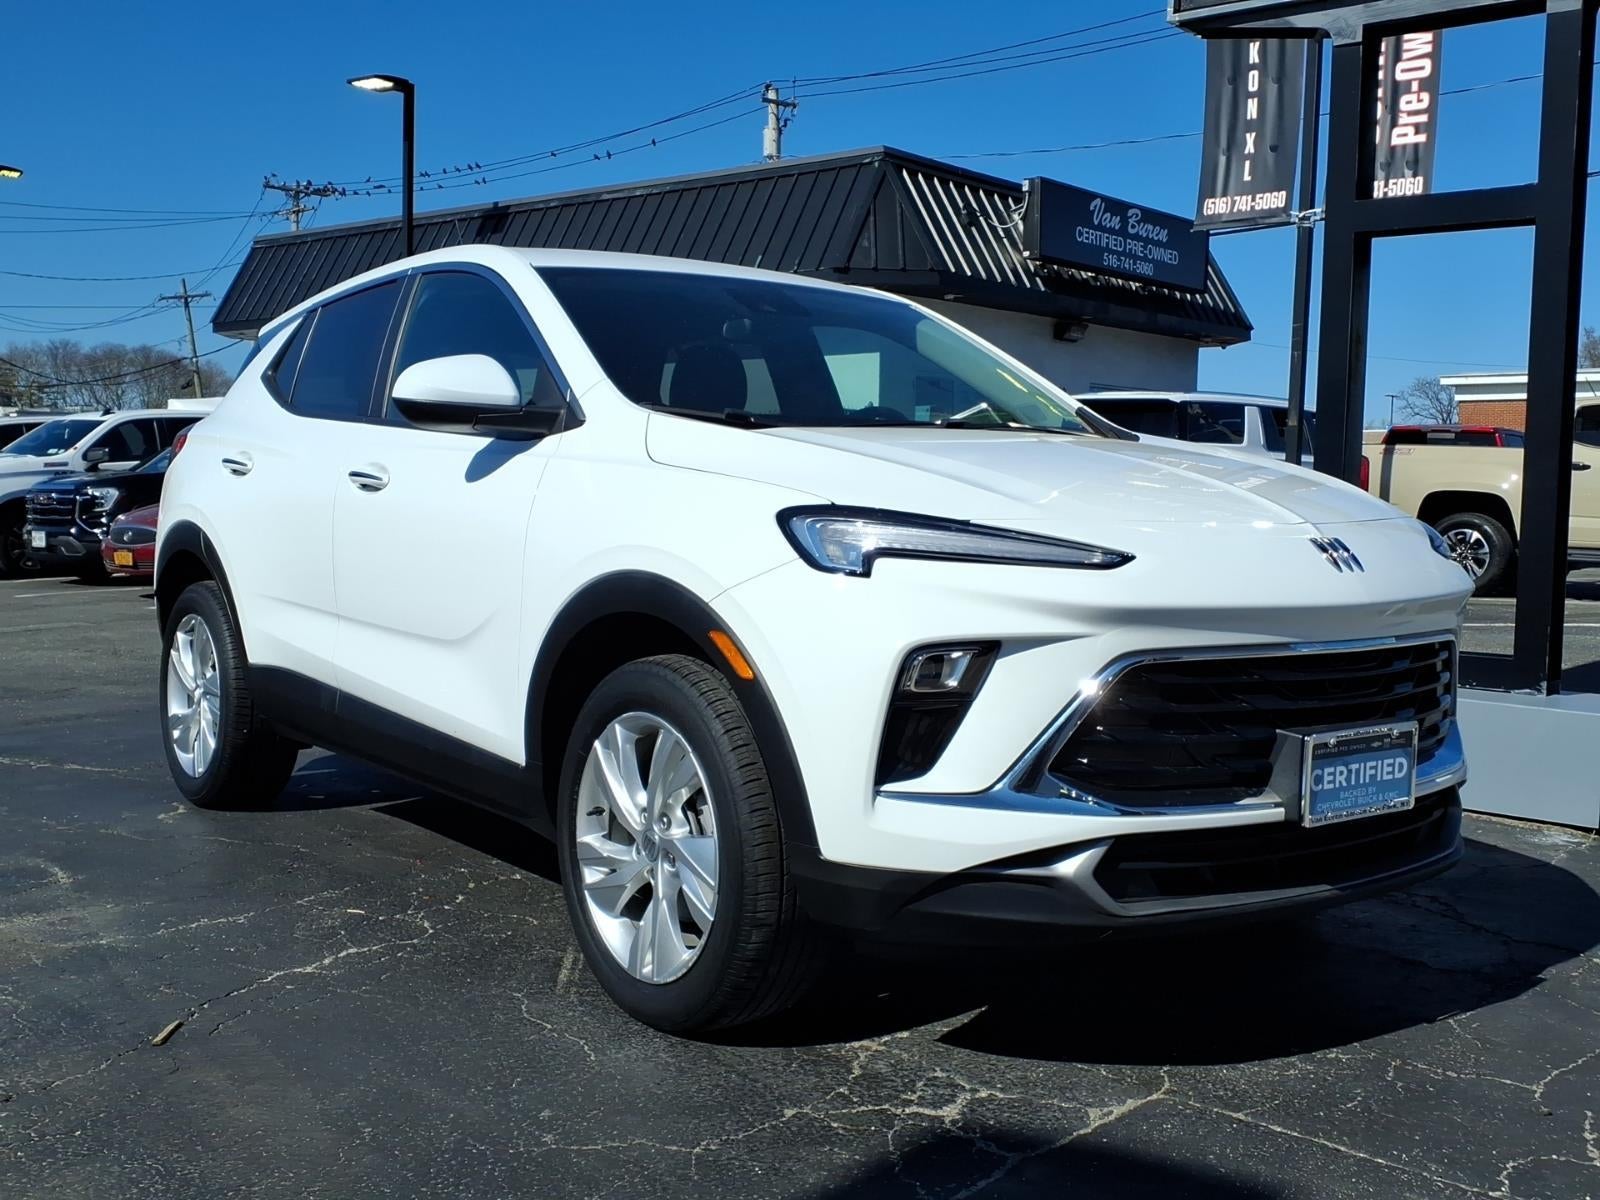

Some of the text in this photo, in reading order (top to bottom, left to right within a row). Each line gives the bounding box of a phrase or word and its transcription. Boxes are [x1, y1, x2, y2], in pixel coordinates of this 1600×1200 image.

[1203, 190, 1287, 216] (516) 741-5060
[1090, 198, 1169, 243] Van Buren
[1076, 226, 1179, 265] CERTIFIED PRE-OWNED
[1103, 252, 1154, 276] 516-741-5060
[1311, 757, 1408, 791] CERTIFIED
[1317, 799, 1355, 811] CHEVROLET
[1358, 795, 1378, 805] BUICK
[1340, 786, 1377, 799] BACKED BY
